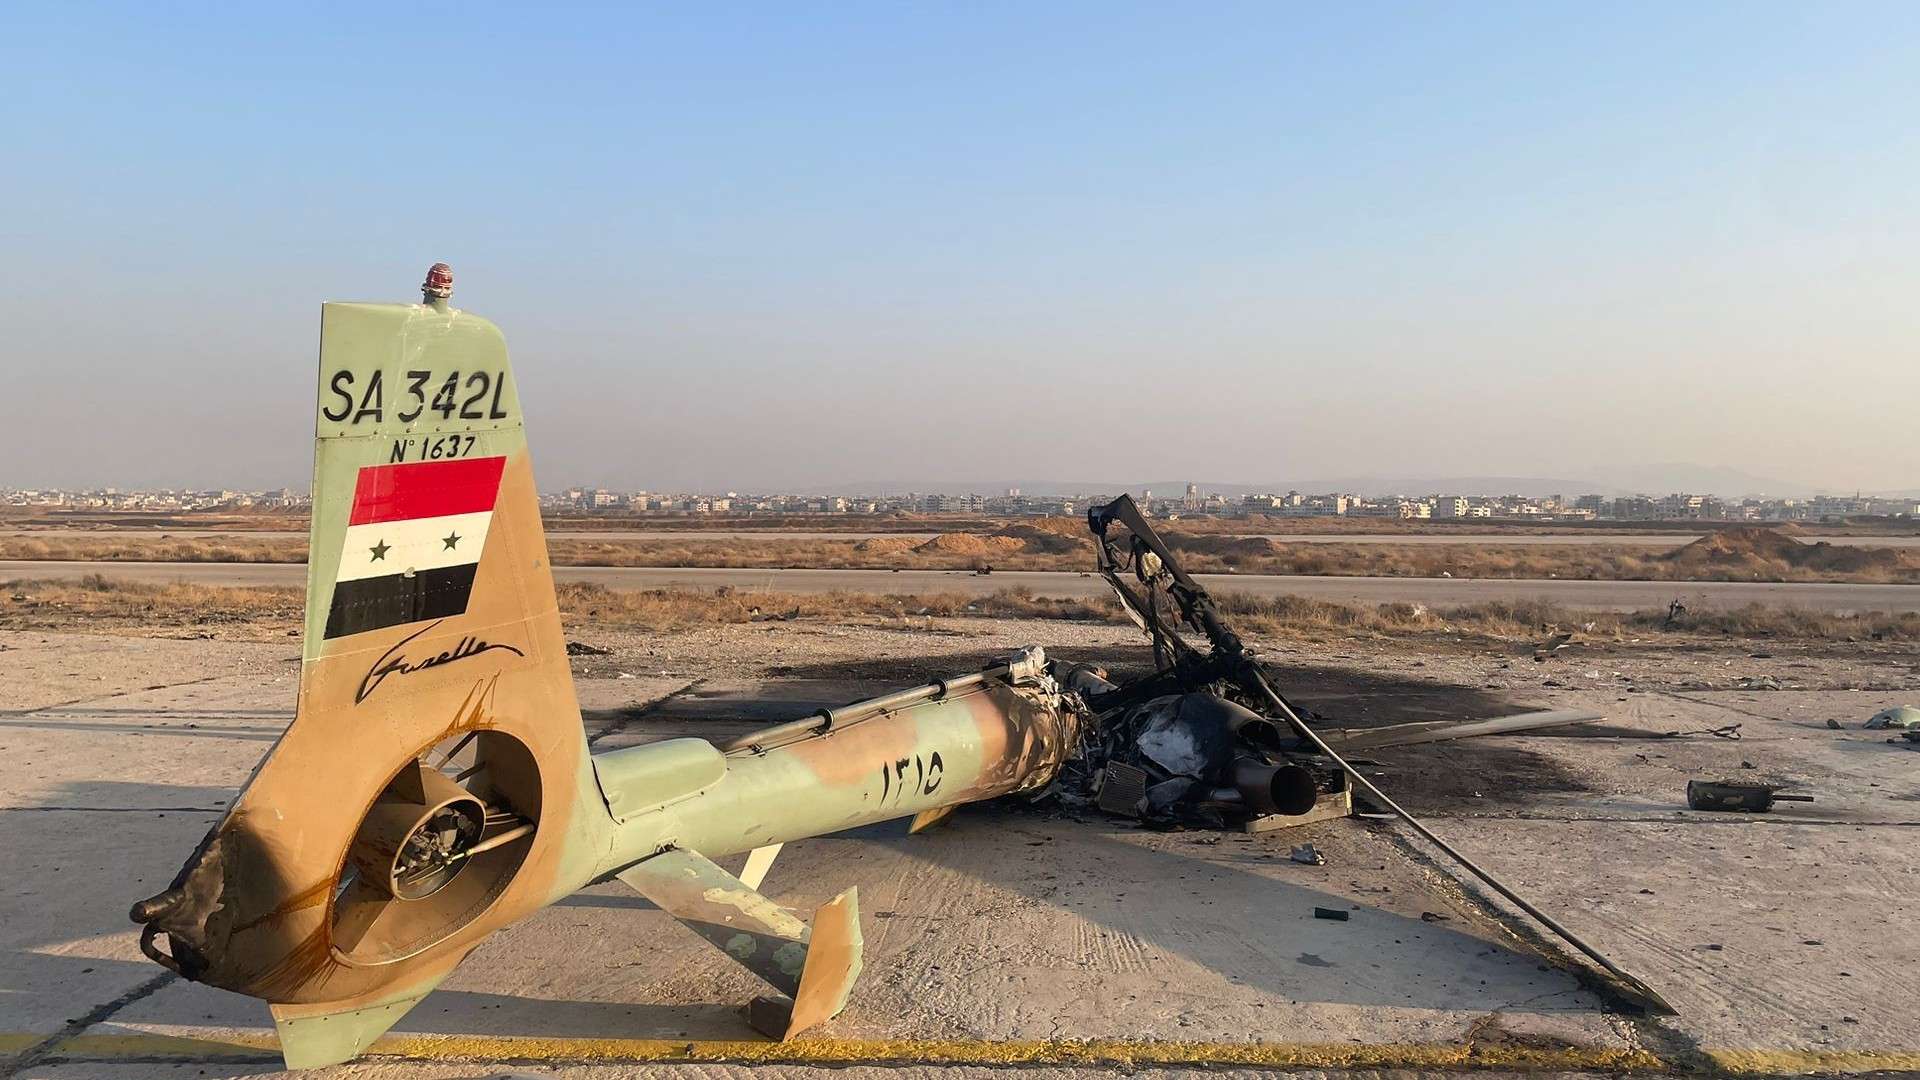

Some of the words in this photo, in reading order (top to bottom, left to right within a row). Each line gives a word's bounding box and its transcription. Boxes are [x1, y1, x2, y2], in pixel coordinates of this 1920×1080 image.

[323, 369, 383, 425] SA
[398, 370, 507, 423] 342L
[421, 434, 475, 460] 1637
[880, 751, 943, 808] ١٣١٥
